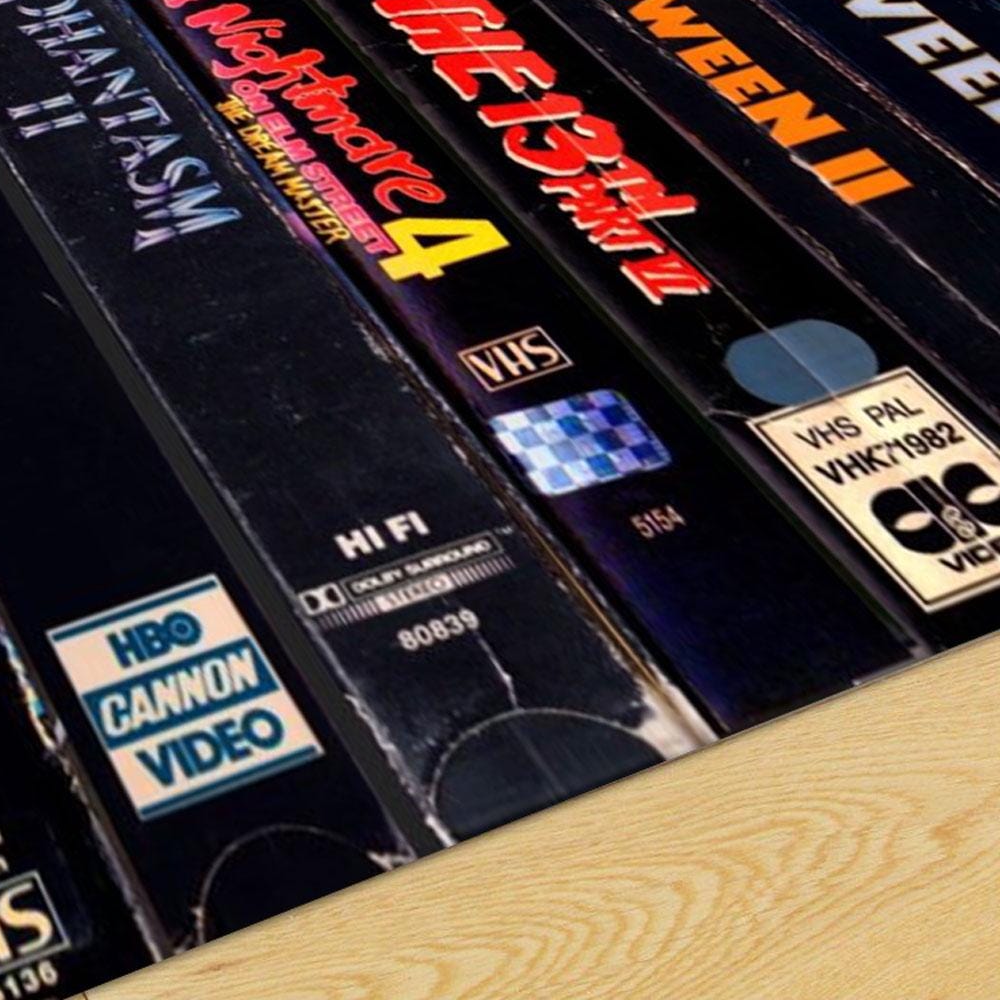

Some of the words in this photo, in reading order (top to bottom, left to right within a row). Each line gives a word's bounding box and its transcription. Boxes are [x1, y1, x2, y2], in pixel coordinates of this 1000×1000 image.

[5, 92, 89, 139] II
[183, 3, 447, 215] Nightmare
[214, 93, 255, 125] THE
[236, 123, 297, 180] DREAM
[275, 174, 351, 246] MASTER
[231, 78, 276, 114] ON
[256, 111, 318, 164] ELM
[299, 161, 399, 255] STREET
[478, 92, 698, 219] 13TH
[811, 146, 914, 207] II
[541, 178, 664, 253] PART
[378, 217, 512, 282] 4
[467, 332, 561, 384] VHS
[794, 416, 863, 450] VHS
[861, 396, 924, 427] PAL
[332, 524, 387, 561] HI
[382, 509, 431, 544] FI
[938, 536, 1000, 573] VID
[350, 567, 404, 594] DOLBY
[403, 538, 493, 576] SURROUND
[105, 610, 204, 670] HBO
[396, 606, 481, 651] 80839
[98, 646, 261, 739] CANNON
[134, 706, 286, 788] VIDEO
